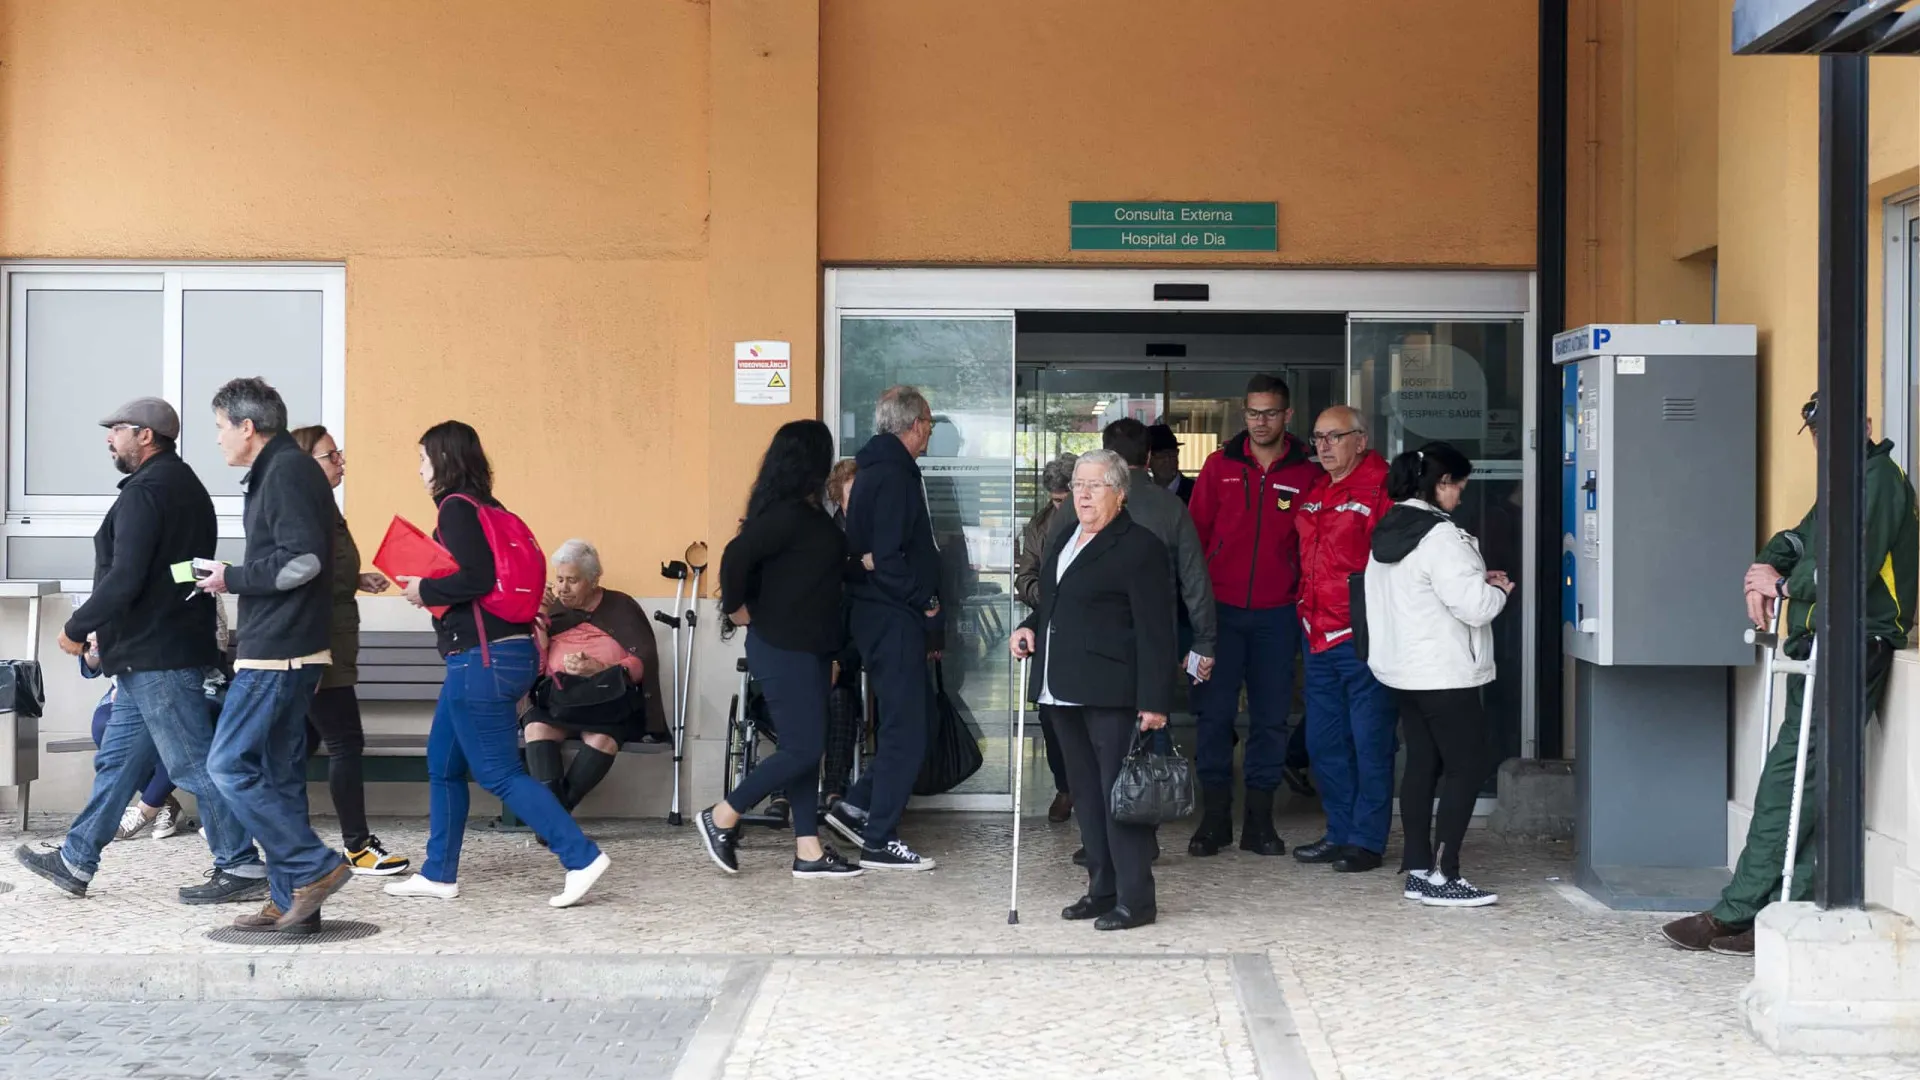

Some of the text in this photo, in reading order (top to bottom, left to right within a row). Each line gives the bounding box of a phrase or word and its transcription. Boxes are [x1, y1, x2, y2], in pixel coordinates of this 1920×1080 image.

[1114, 207, 1233, 221] Consulta Externa
[1121, 232, 1226, 248] Hospital de Dia
[1593, 328, 1611, 350] P
[1400, 390, 1467, 400] SEM TABACO
[1402, 409, 1446, 418] RESPIRE
